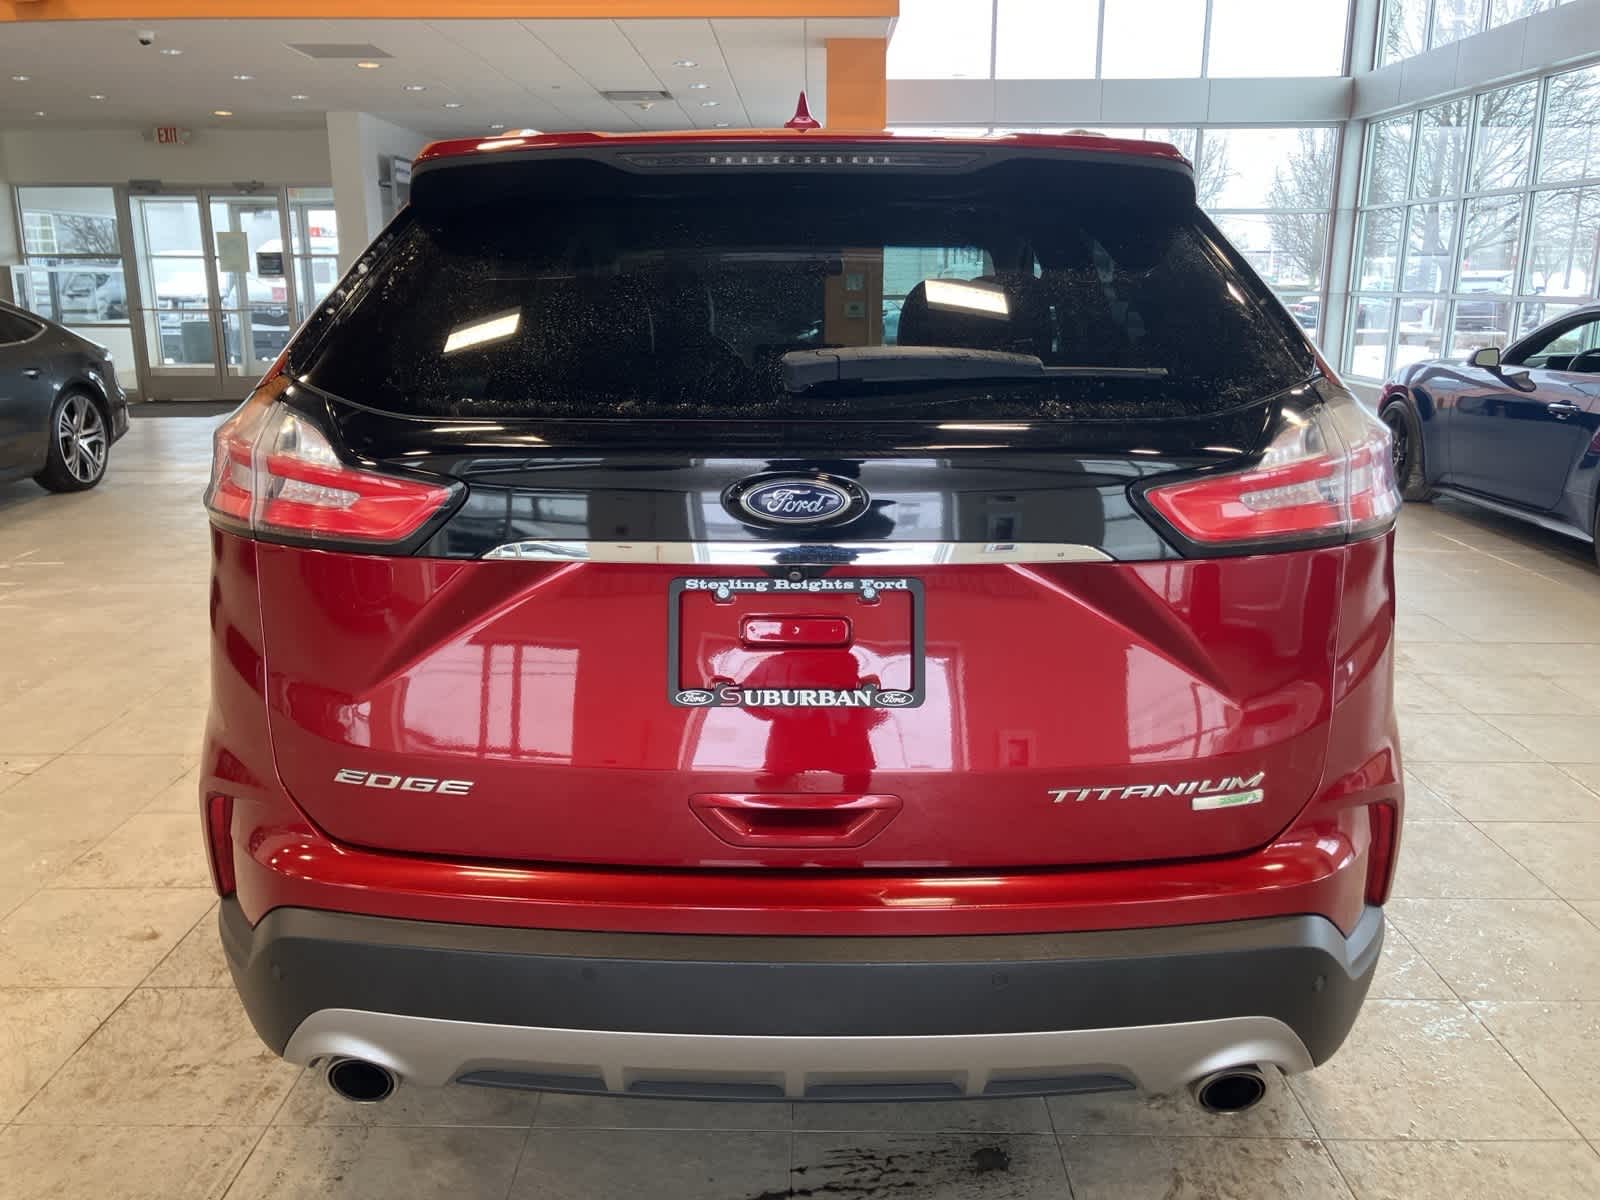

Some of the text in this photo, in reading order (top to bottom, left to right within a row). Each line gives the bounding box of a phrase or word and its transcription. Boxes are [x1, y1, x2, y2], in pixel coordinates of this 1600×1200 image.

[157, 128, 178, 144] EXIT
[767, 488, 824, 513] Ford
[685, 579, 909, 591] Sterling Heights Ford
[720, 687, 872, 706] SUBURBAN
[334, 768, 475, 796] EDGE
[1048, 771, 1265, 803] TITANIUM
